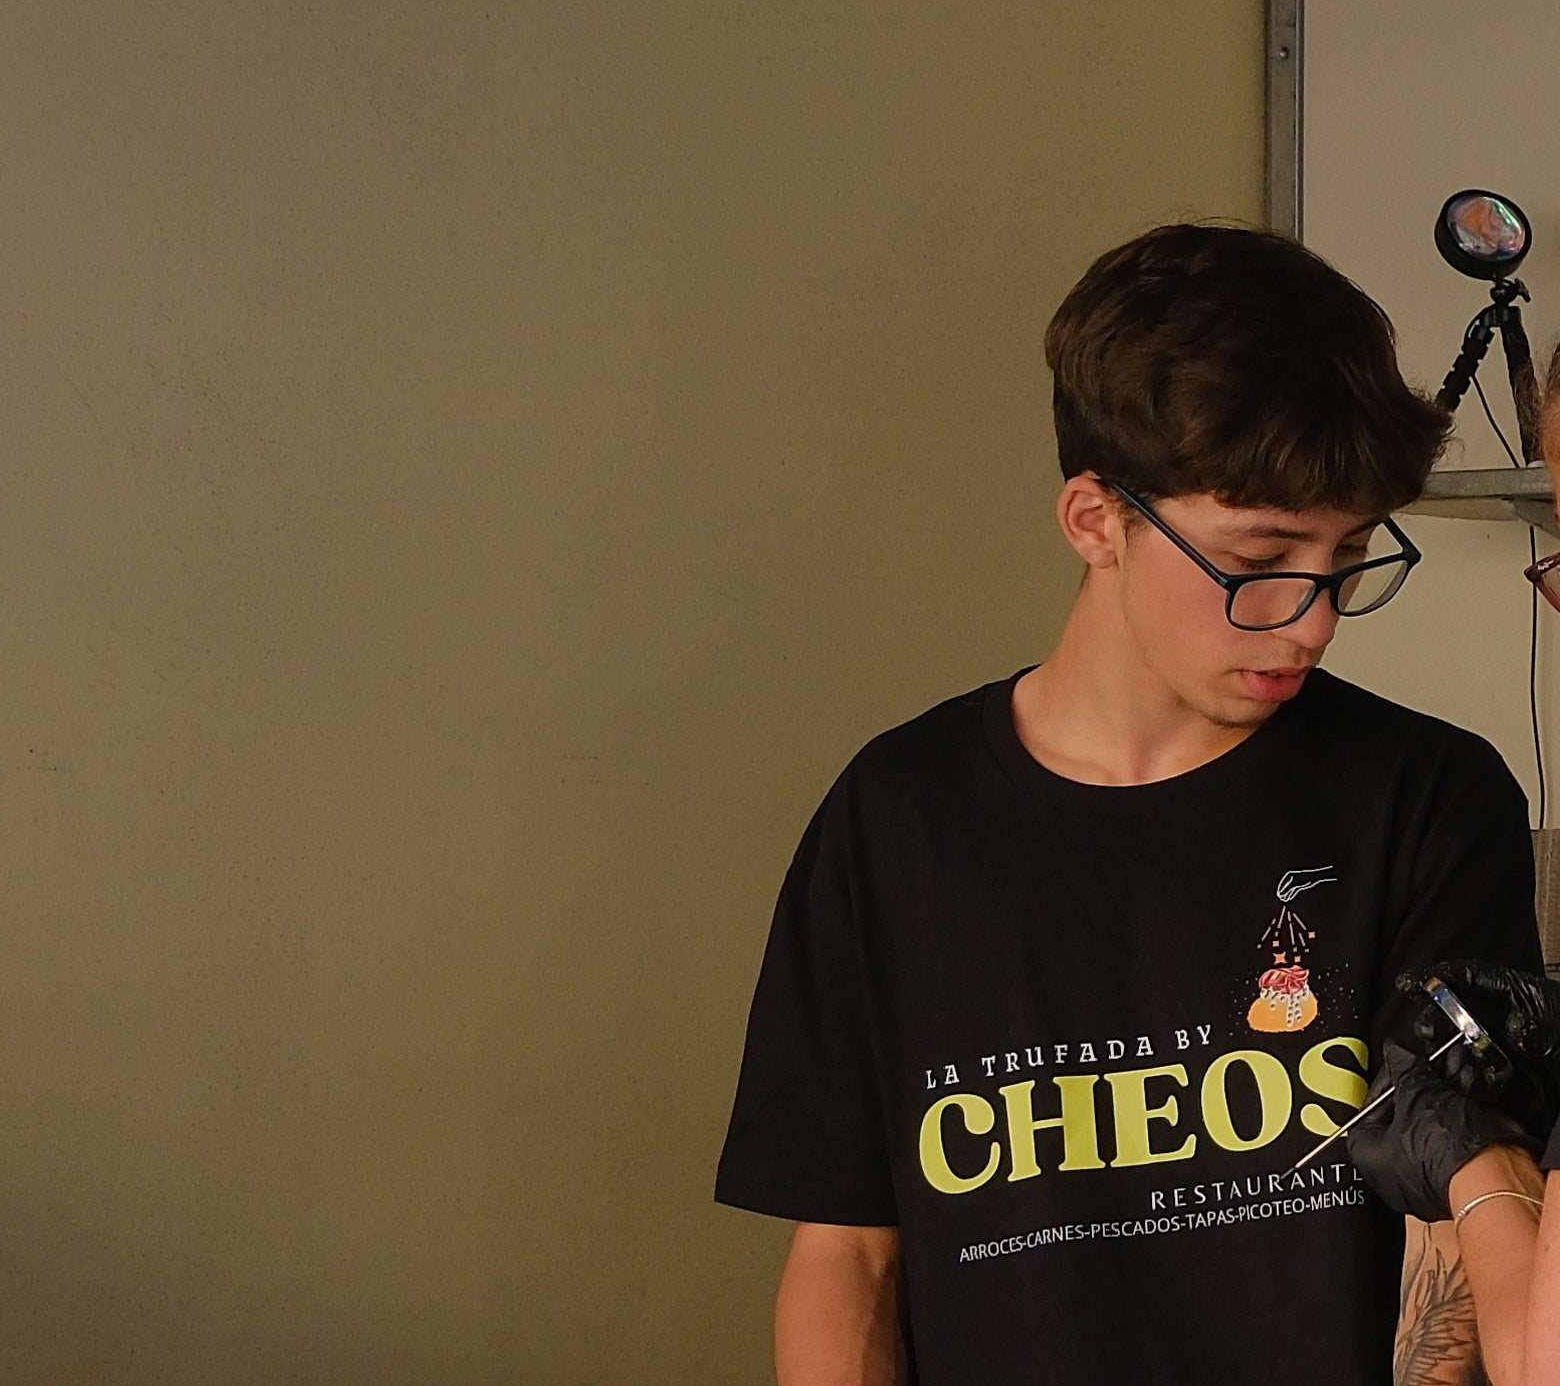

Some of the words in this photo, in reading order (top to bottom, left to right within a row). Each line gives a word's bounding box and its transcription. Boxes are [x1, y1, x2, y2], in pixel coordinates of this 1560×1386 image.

[925, 1063, 960, 1090] LA
[981, 1035, 1155, 1078] TRUFADA
[1174, 1023, 1212, 1051] BY
[918, 1035, 1369, 1196] CHEOS
[958, 1185, 1366, 1264] ARROCES-CARNES-PESCADOS-TAPAS-PICOTEO-MENÚS
